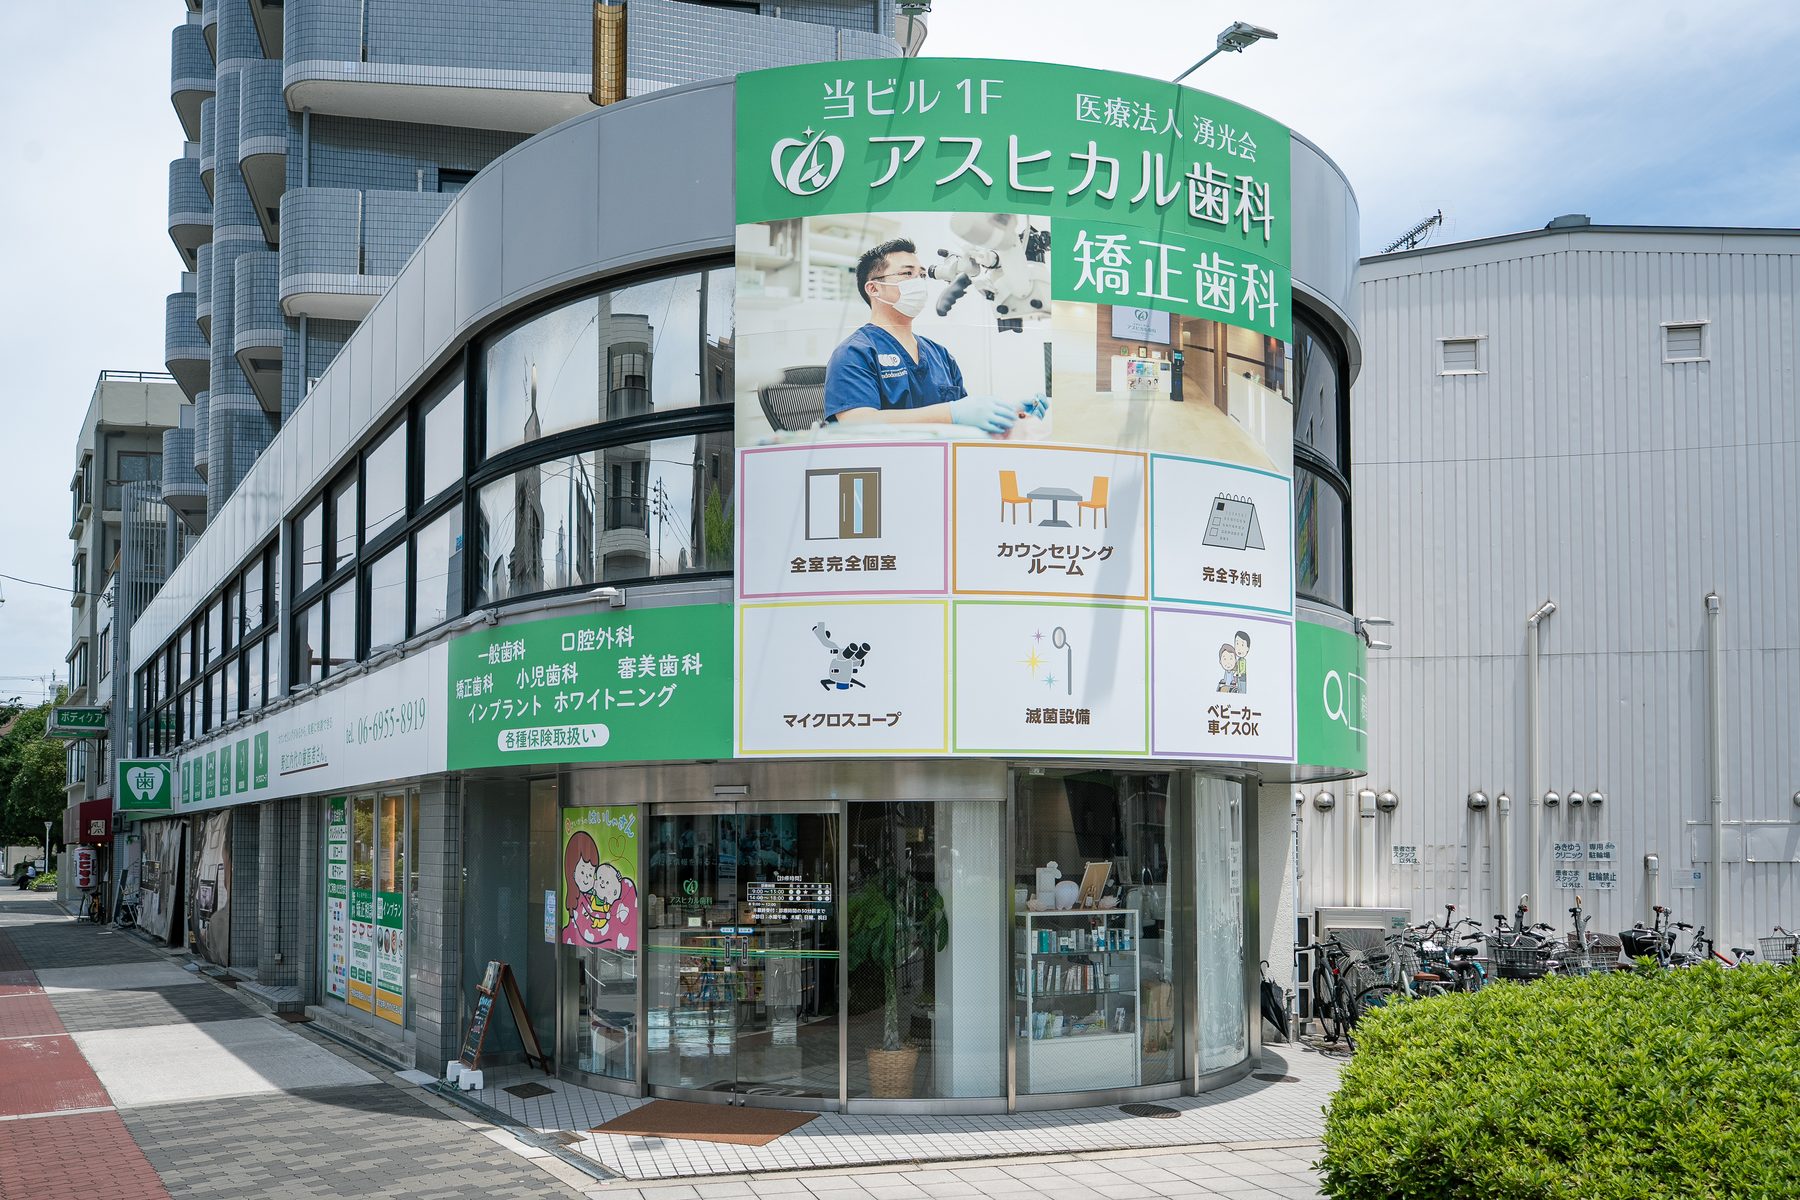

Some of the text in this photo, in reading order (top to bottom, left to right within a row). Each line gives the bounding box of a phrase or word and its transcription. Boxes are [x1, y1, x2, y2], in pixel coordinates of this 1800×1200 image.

[823, 78, 1004, 120] 当ビル 1F
[1075, 92, 1258, 164] 医療法人 湧光会
[868, 133, 1275, 242] アスヒカル歯科
[1072, 229, 1279, 328] 矯正歯科
[997, 541, 1114, 563] カウンセリング
[790, 554, 897, 574] 全室完全個室
[1027, 559, 1085, 577] ルーム
[1202, 566, 1262, 588] 完全予約制
[478, 624, 635, 665] 一般歯科 口腔外科
[455, 652, 703, 700] 矯正歯科 小児歯科 審美歯科
[468, 683, 678, 724] インプラント ホワイトニング
[1208, 704, 1263, 720] ベビーカー
[61, 711, 103, 724] ボディケア
[357, 697, 426, 745] 06-6955-8919
[783, 711, 902, 728] マイクロスコープ
[1025, 708, 1091, 726] 滅菌設備
[505, 727, 597, 749] 各種保険取扱い
[1208, 719, 1259, 738] 車イスOK
[135, 772, 156, 790] 歯
[1588, 872, 1617, 882] 駐輪禁止
